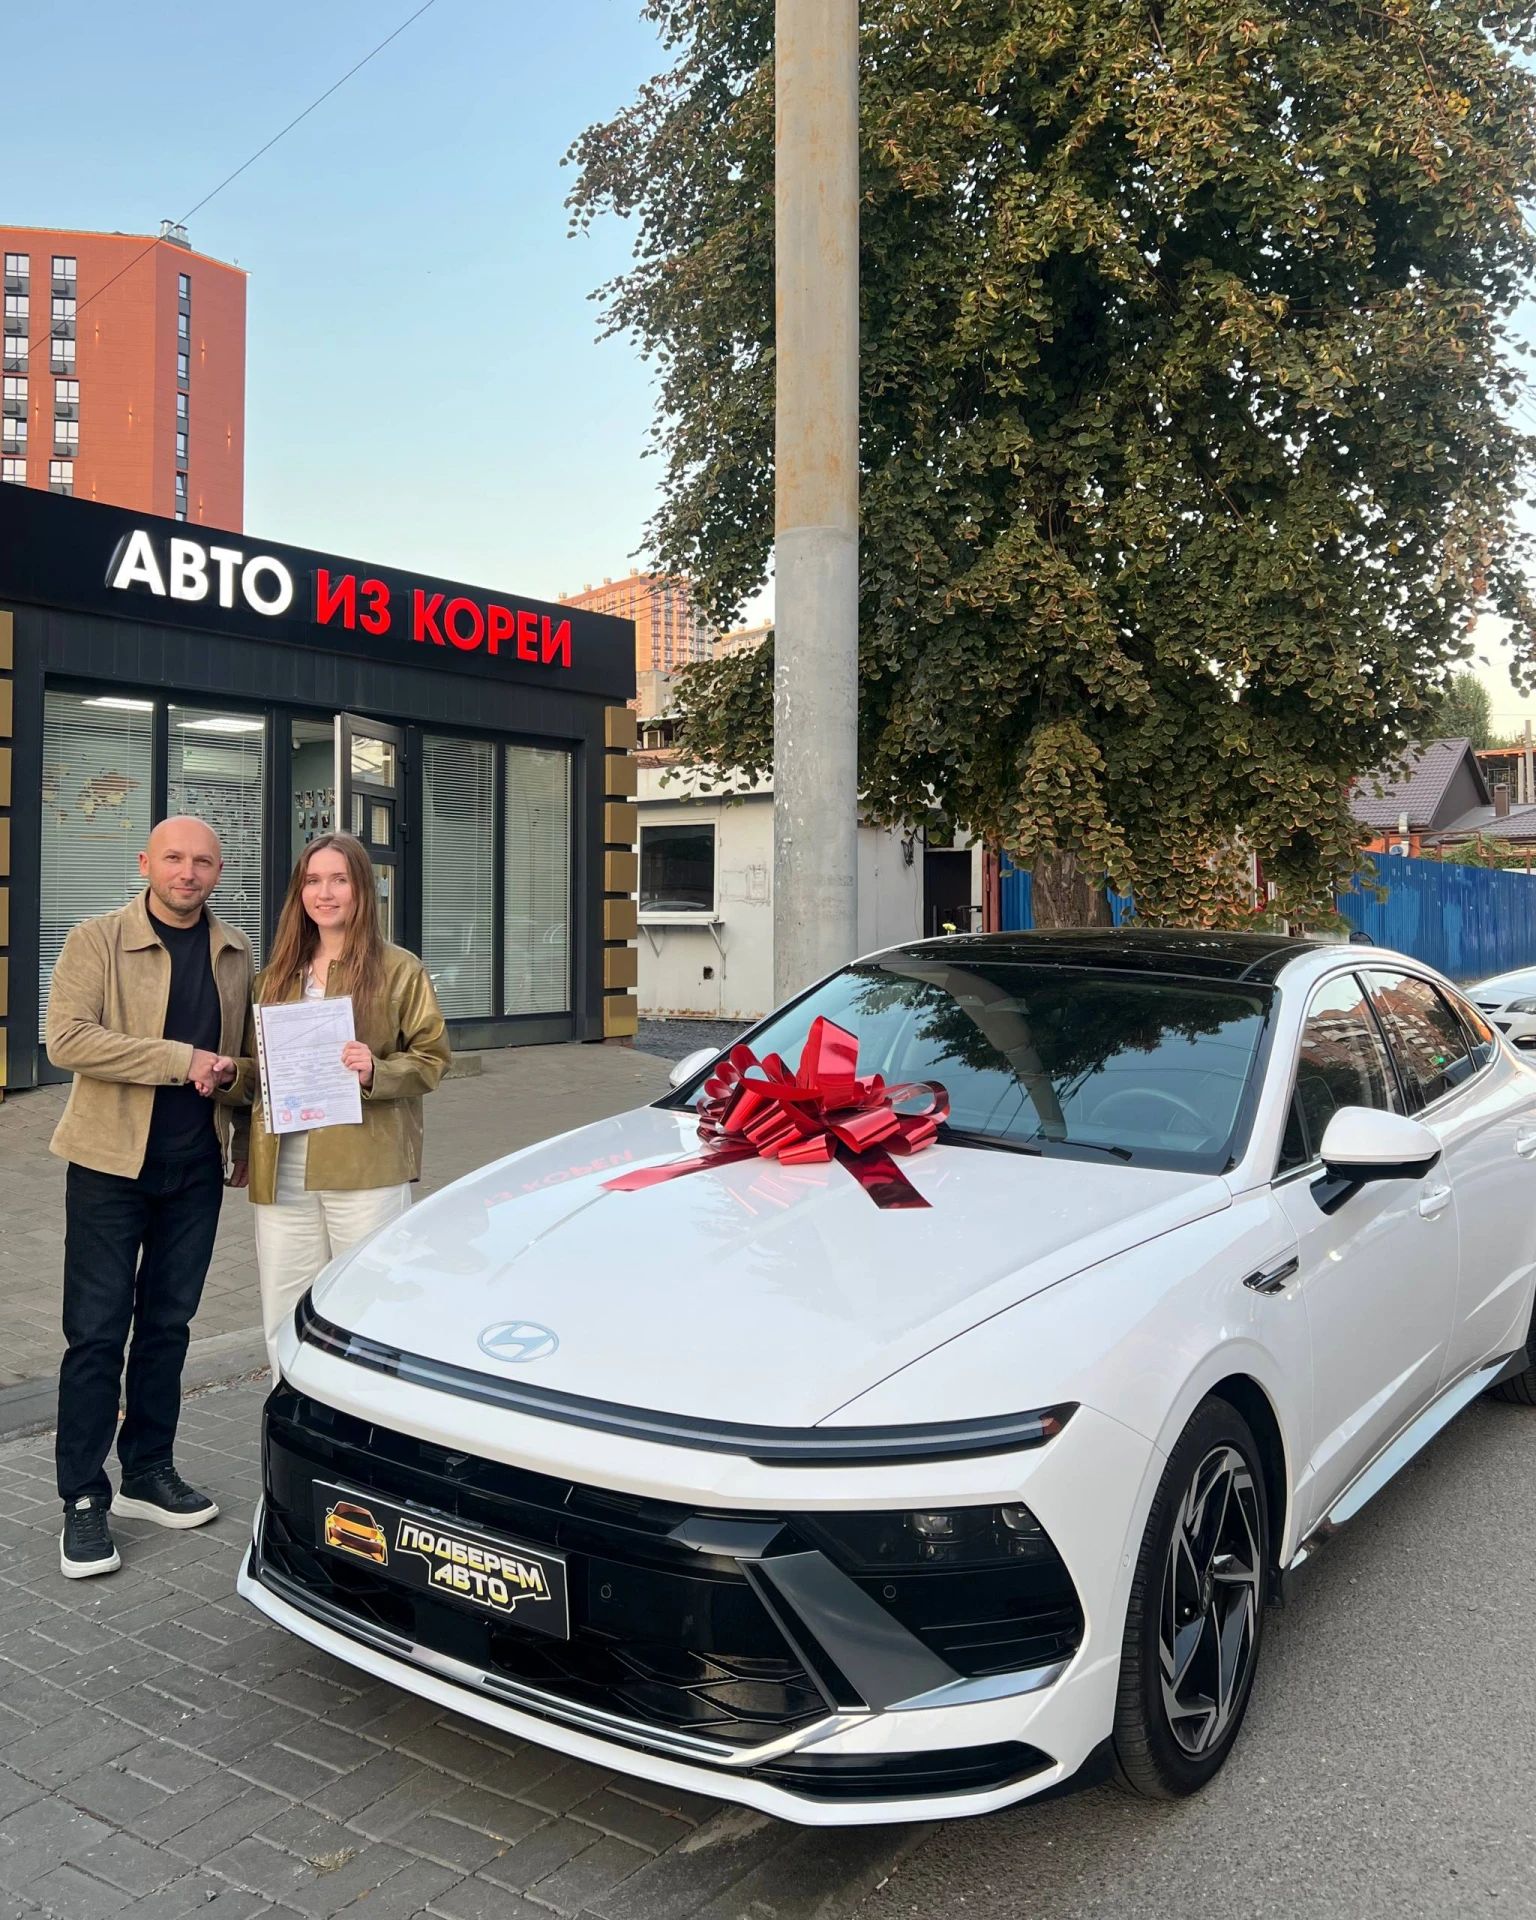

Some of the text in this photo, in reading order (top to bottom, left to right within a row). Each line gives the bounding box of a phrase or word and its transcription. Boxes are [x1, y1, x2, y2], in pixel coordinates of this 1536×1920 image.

[112, 529, 572, 668] АВТО ИЗ КОРЕИ
[401, 1525, 544, 1592] ПОДБЕРЕМ
[434, 1562, 509, 1604] АВТО
